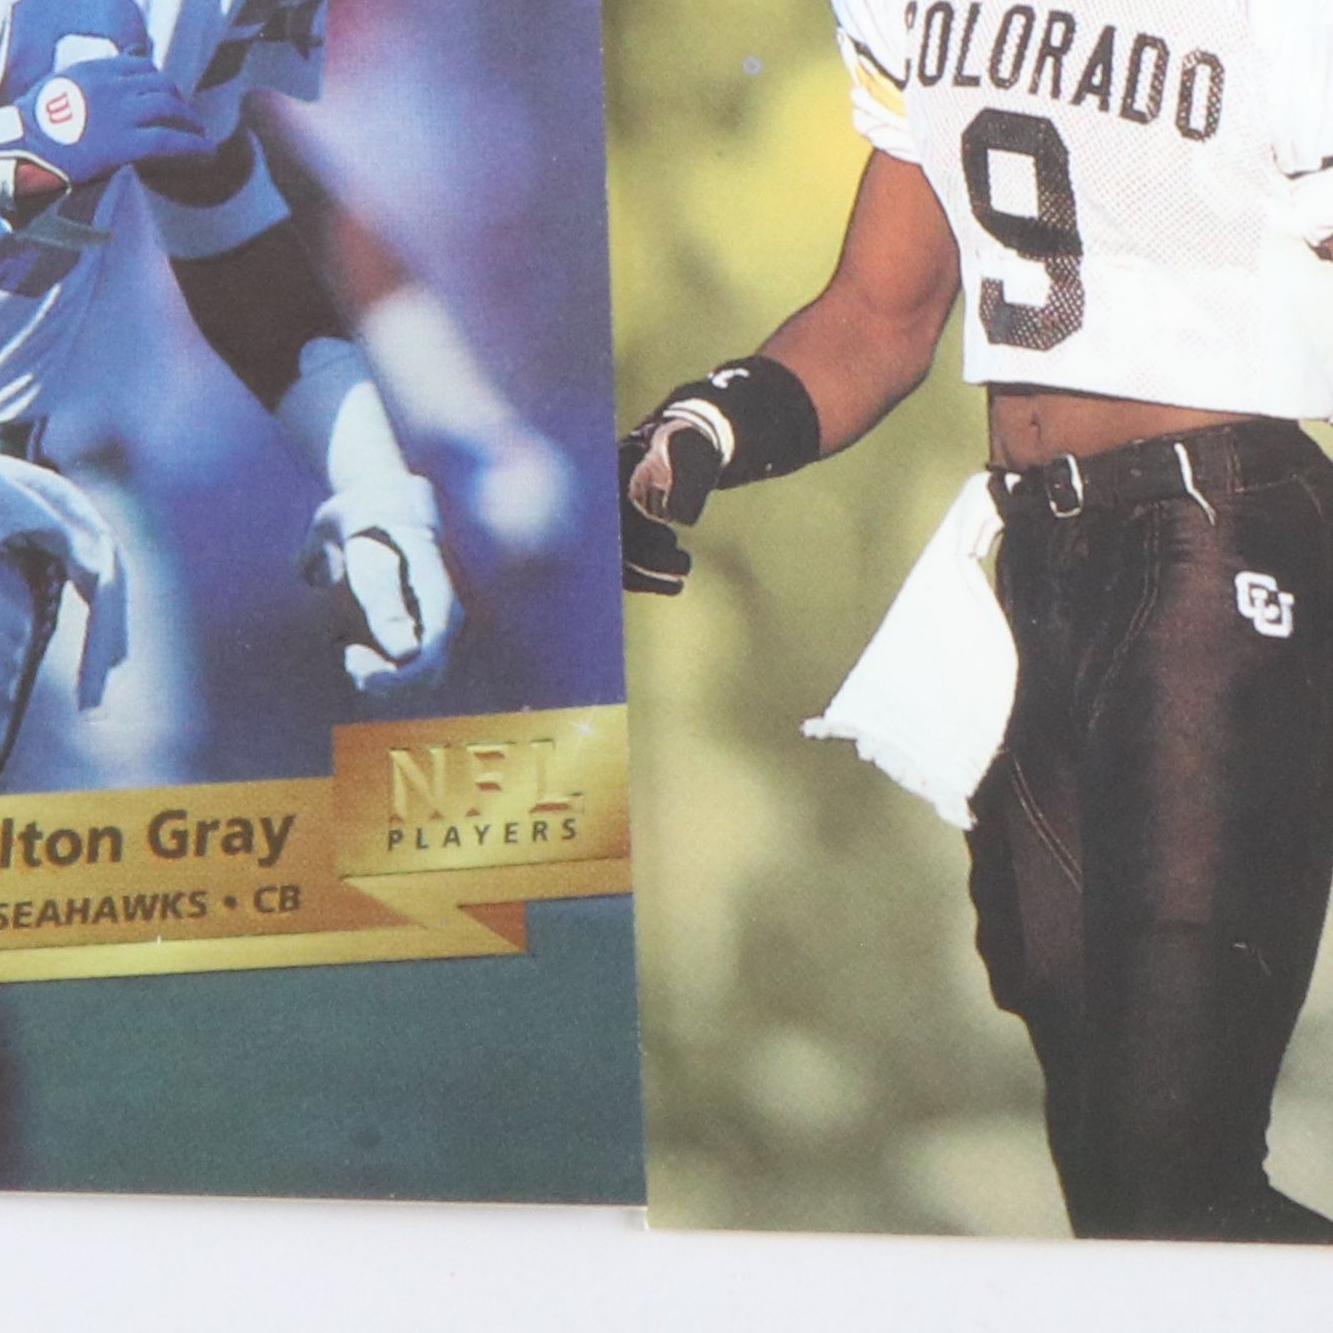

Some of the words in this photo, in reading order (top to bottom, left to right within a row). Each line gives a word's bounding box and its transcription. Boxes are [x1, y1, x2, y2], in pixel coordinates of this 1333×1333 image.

[961, 107, 1085, 351] 9
[387, 737, 585, 823] NFL
[146, 809, 297, 867] Gray
[387, 817, 579, 853] PLAYERS
[253, 884, 302, 915] CB
